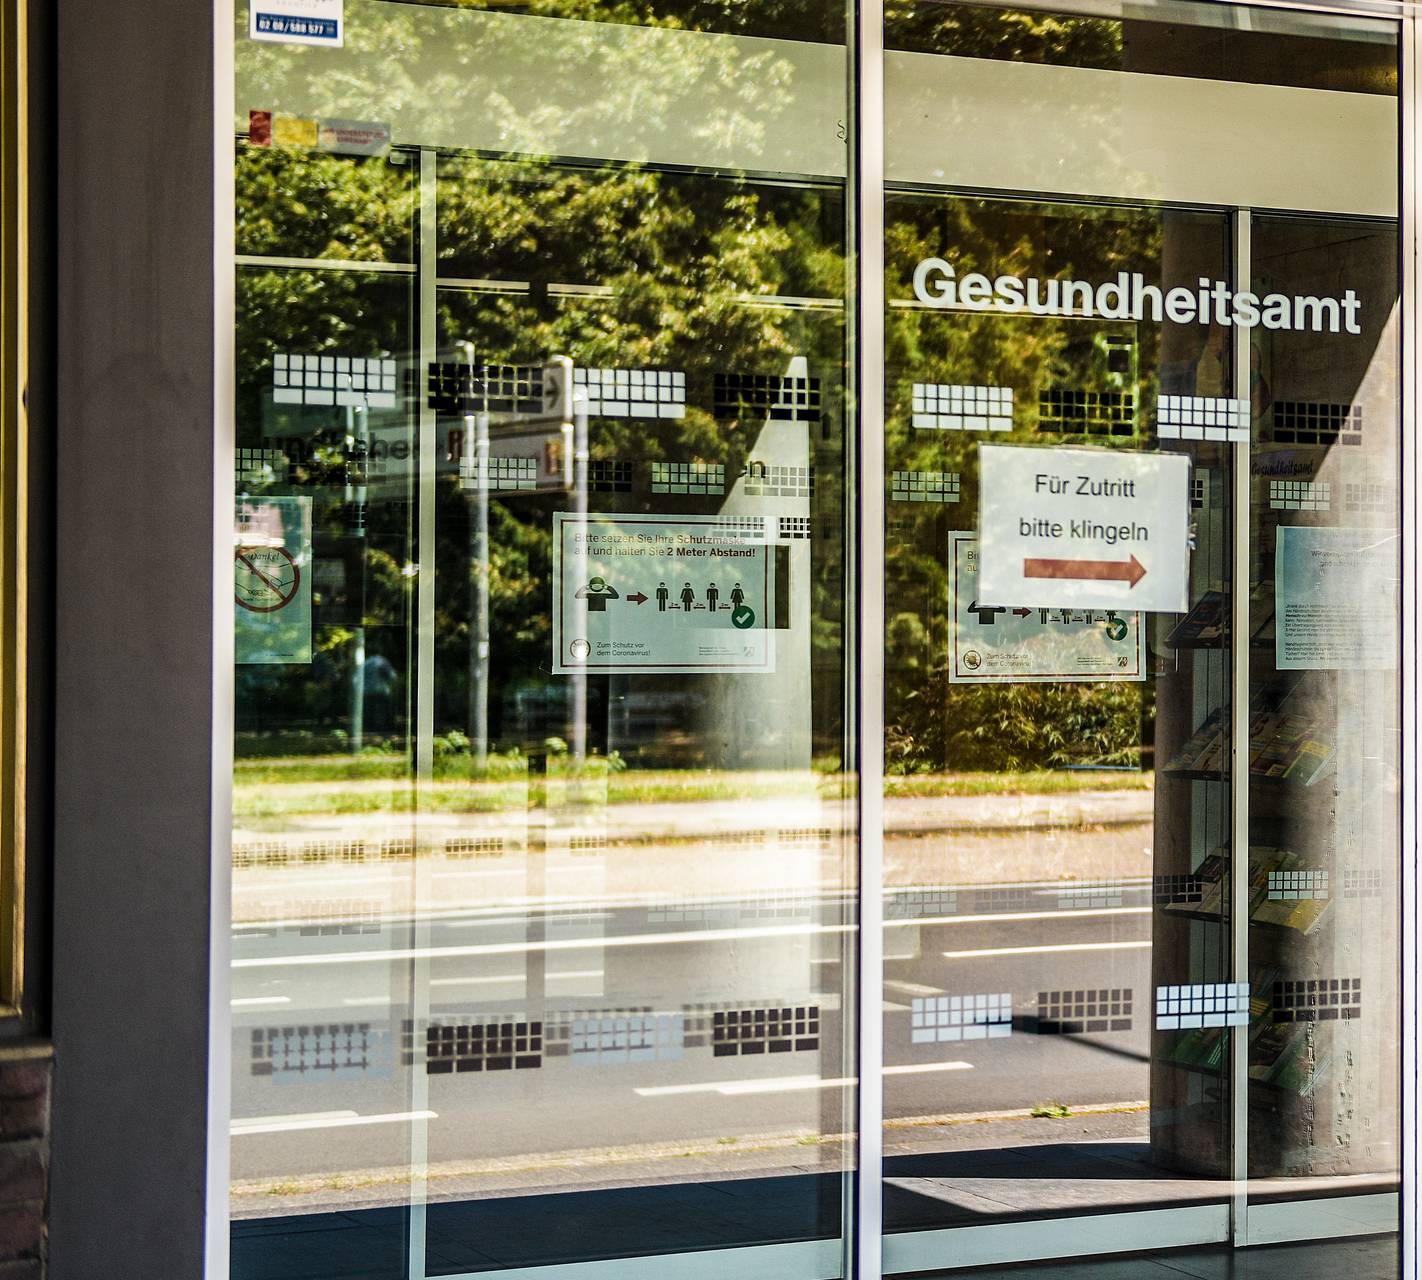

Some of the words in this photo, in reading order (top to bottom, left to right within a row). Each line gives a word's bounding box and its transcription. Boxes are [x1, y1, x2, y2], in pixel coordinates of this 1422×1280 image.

[912, 257, 1362, 335] Gesundheitsamt
[1035, 474, 1070, 494] Für
[1076, 476, 1135, 498] Zutritt
[574, 532, 599, 543] Btte
[637, 533, 653, 544] Sie
[655, 534, 674, 544] Ihre
[1019, 517, 1063, 538] bitte
[1070, 520, 1149, 545] klingeln
[574, 546, 591, 556] af
[593, 546, 613, 556] und
[649, 546, 665, 557] Sie
[667, 547, 674, 557] 2
[676, 547, 708, 557] Meter
[709, 547, 756, 558] Abstand!
[596, 641, 611, 649] Zum
[612, 641, 634, 649] Schutz
